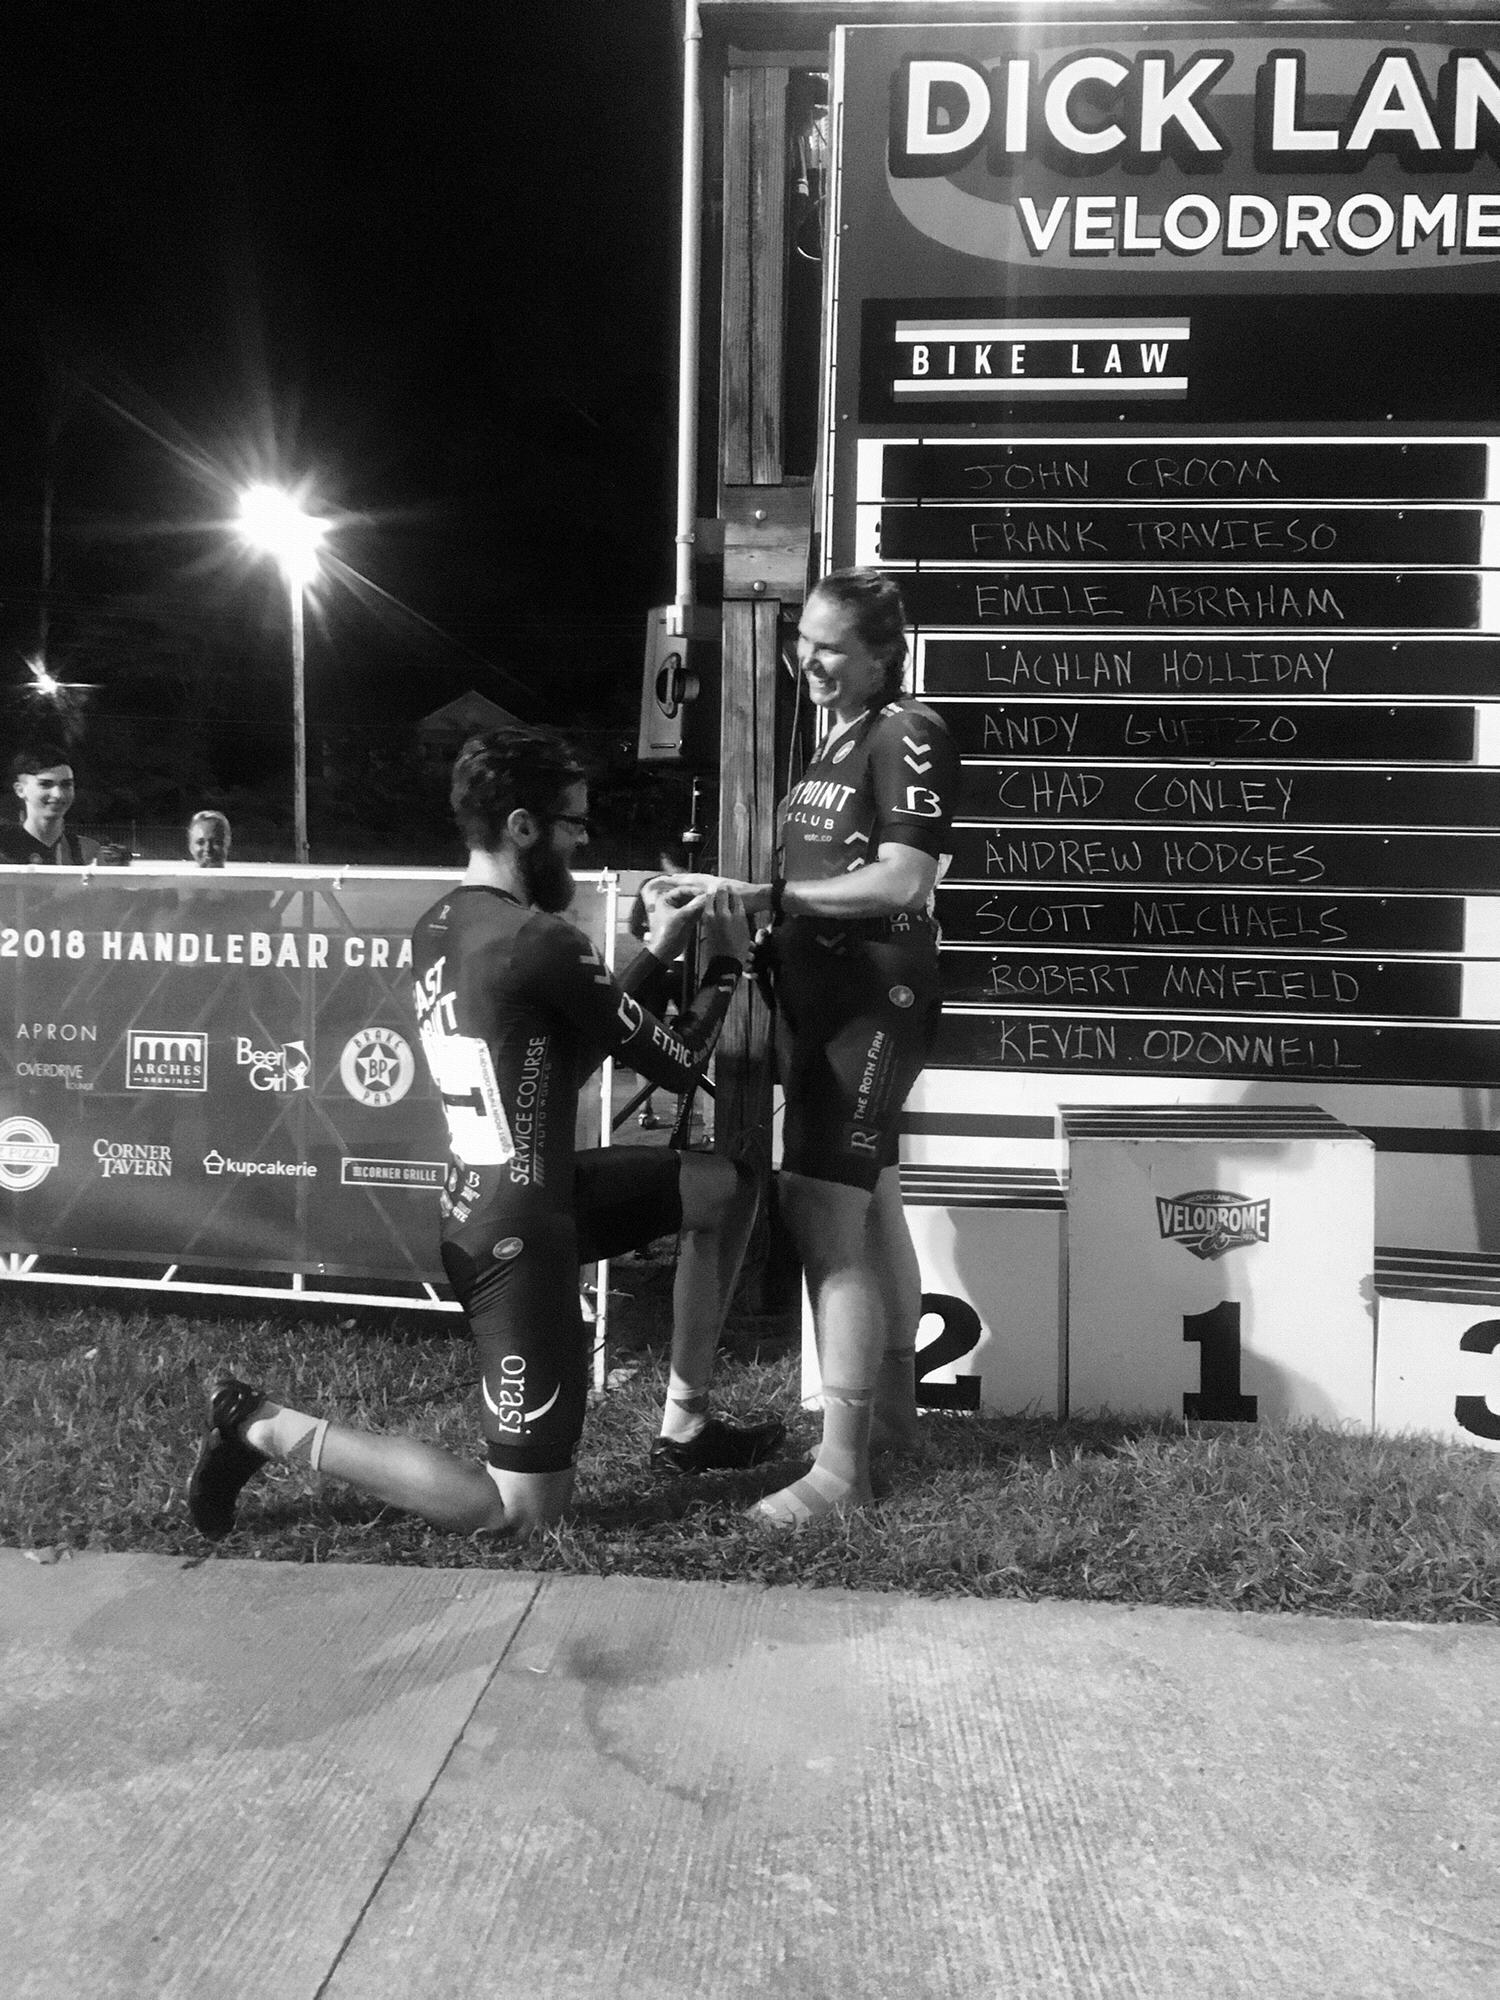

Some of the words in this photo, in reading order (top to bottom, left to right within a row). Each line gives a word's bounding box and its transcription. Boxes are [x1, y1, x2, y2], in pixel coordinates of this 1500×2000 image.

[906, 56, 1225, 154] DICK
[1271, 55, 1500, 151] LAN
[1018, 193, 1500, 251] VELODROME
[911, 345, 1026, 376] BIKE
[1070, 343, 1171, 374] LAW
[964, 460, 1089, 490] JOHN
[1127, 457, 1280, 488] CROOM
[970, 521, 1108, 553] FRANK
[1128, 518, 1337, 553] TRAVIESO
[975, 584, 1124, 618] EMILE
[1147, 584, 1345, 620] ABRAHAM
[985, 648, 1132, 686] LACHLAN
[1162, 648, 1335, 690] HOLLIDAY
[983, 712, 1080, 752] ANDY
[998, 773, 1104, 813] CHAD
[1134, 776, 1296, 820] CONLEY
[794, 811, 835, 830] CLUB
[985, 840, 1142, 875] ANDREW
[1164, 841, 1326, 883] HODGES
[975, 900, 1105, 935] SCOTT
[1132, 901, 1349, 942] MICHAELS
[0, 928, 86, 959] 2018
[102, 932, 328, 968] HANDLEBAR
[988, 964, 1140, 997] ROBERT
[1164, 966, 1359, 1002] MAYFIELD
[16, 1023, 97, 1041] APRON
[353, 1029, 404, 1050] BRAKE
[867, 1030, 886, 1060] FIRM
[1143, 1027, 1362, 1070] ODONNELL
[236, 1037, 284, 1066] Beer
[368, 1058, 388, 1079] BP
[133, 1063, 201, 1076] ARCHES
[249, 1064, 287, 1092] Girl
[516, 1036, 547, 1108] COURSE
[858, 1061, 877, 1095] ROTH
[362, 1090, 392, 1105] PAD
[853, 1096, 869, 1120] THE
[8, 1146, 51, 1161] PIZZA
[93, 1138, 172, 1161] CORNER
[510, 1112, 534, 1186] SERVICE
[98, 1157, 173, 1178] TAVERN
[227, 1158, 318, 1178] kupcakerie
[362, 1165, 401, 1180] CORNER
[403, 1167, 438, 1182] GRILLE
[1160, 1201, 1268, 1238] VELODROME
[915, 1293, 982, 1411] 2
[1182, 1301, 1258, 1423] 1
